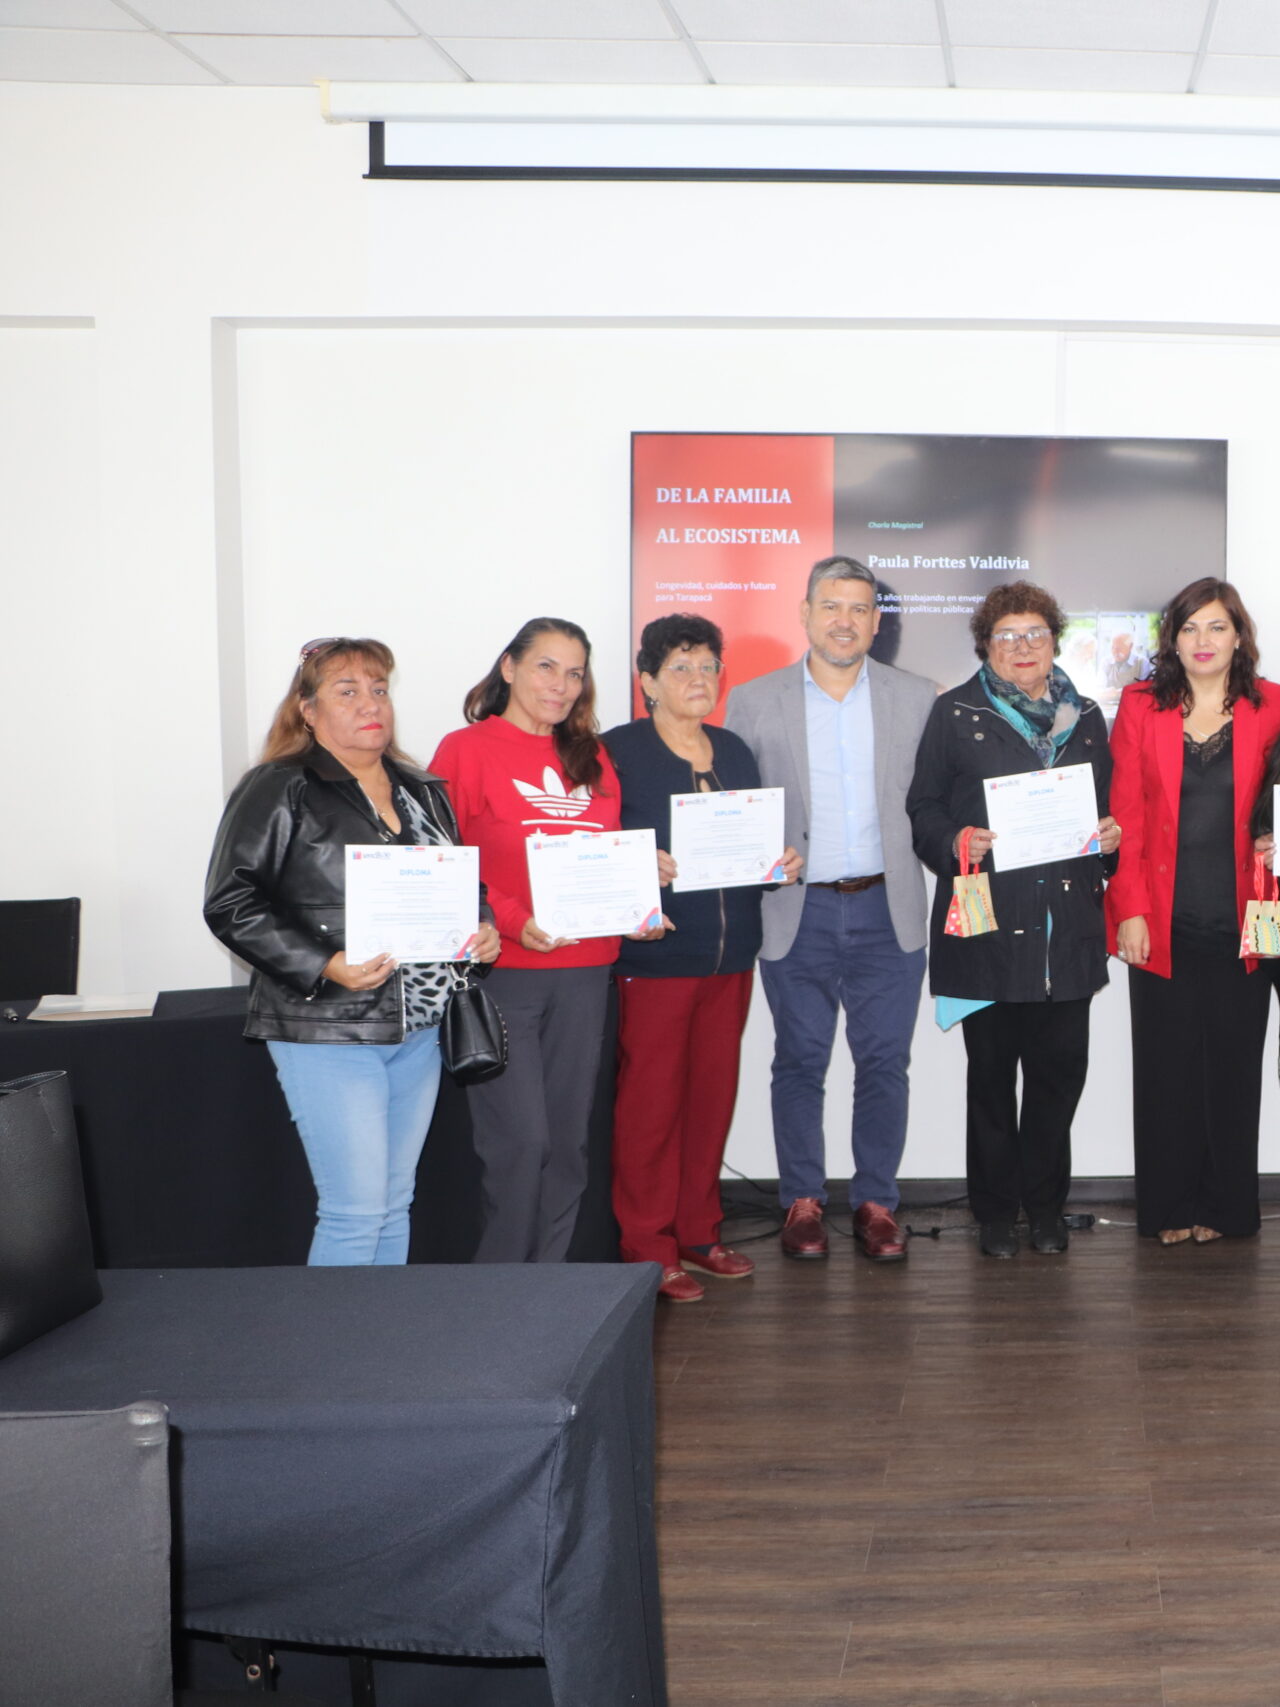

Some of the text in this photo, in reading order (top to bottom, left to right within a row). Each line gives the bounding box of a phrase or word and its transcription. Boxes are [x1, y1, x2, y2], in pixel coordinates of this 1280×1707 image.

[656, 487, 792, 504] DE LA FAMILIA
[891, 521, 924, 531] Magistral
[656, 528, 801, 544] AL ECOSISTEMA
[868, 555, 1030, 570] Paula Forttes Valdivia
[705, 581, 742, 590] cuidados
[743, 583, 749, 592] y
[750, 581, 777, 591] futuro
[676, 592, 713, 603] Tarapacá
[883, 592, 902, 602] años
[903, 593, 946, 603] trabajando
[903, 606, 909, 615] y
[909, 604, 942, 615] políticas
[943, 604, 975, 615] públicas
